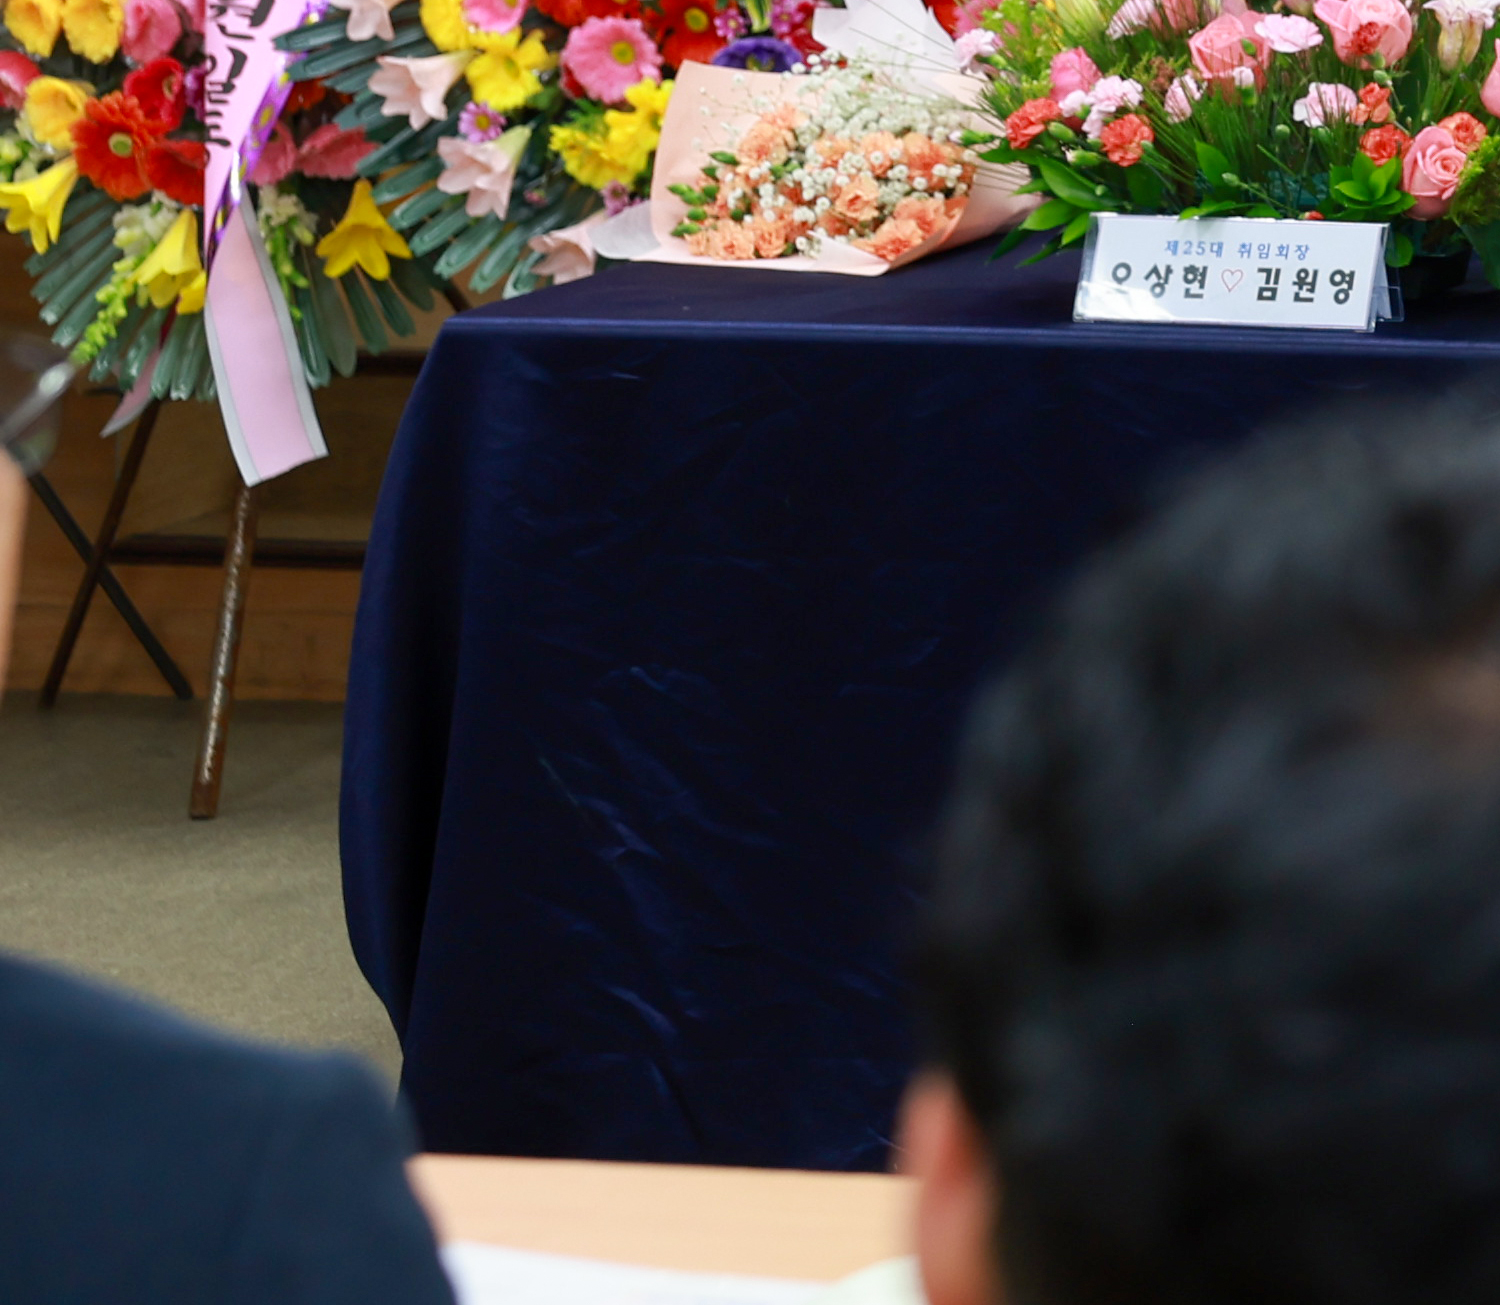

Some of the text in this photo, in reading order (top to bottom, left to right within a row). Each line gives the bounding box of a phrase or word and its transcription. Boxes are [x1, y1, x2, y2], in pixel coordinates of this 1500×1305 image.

[1164, 239, 1311, 261] 제25대 취임회장
[1256, 267, 1356, 305] 김원영
